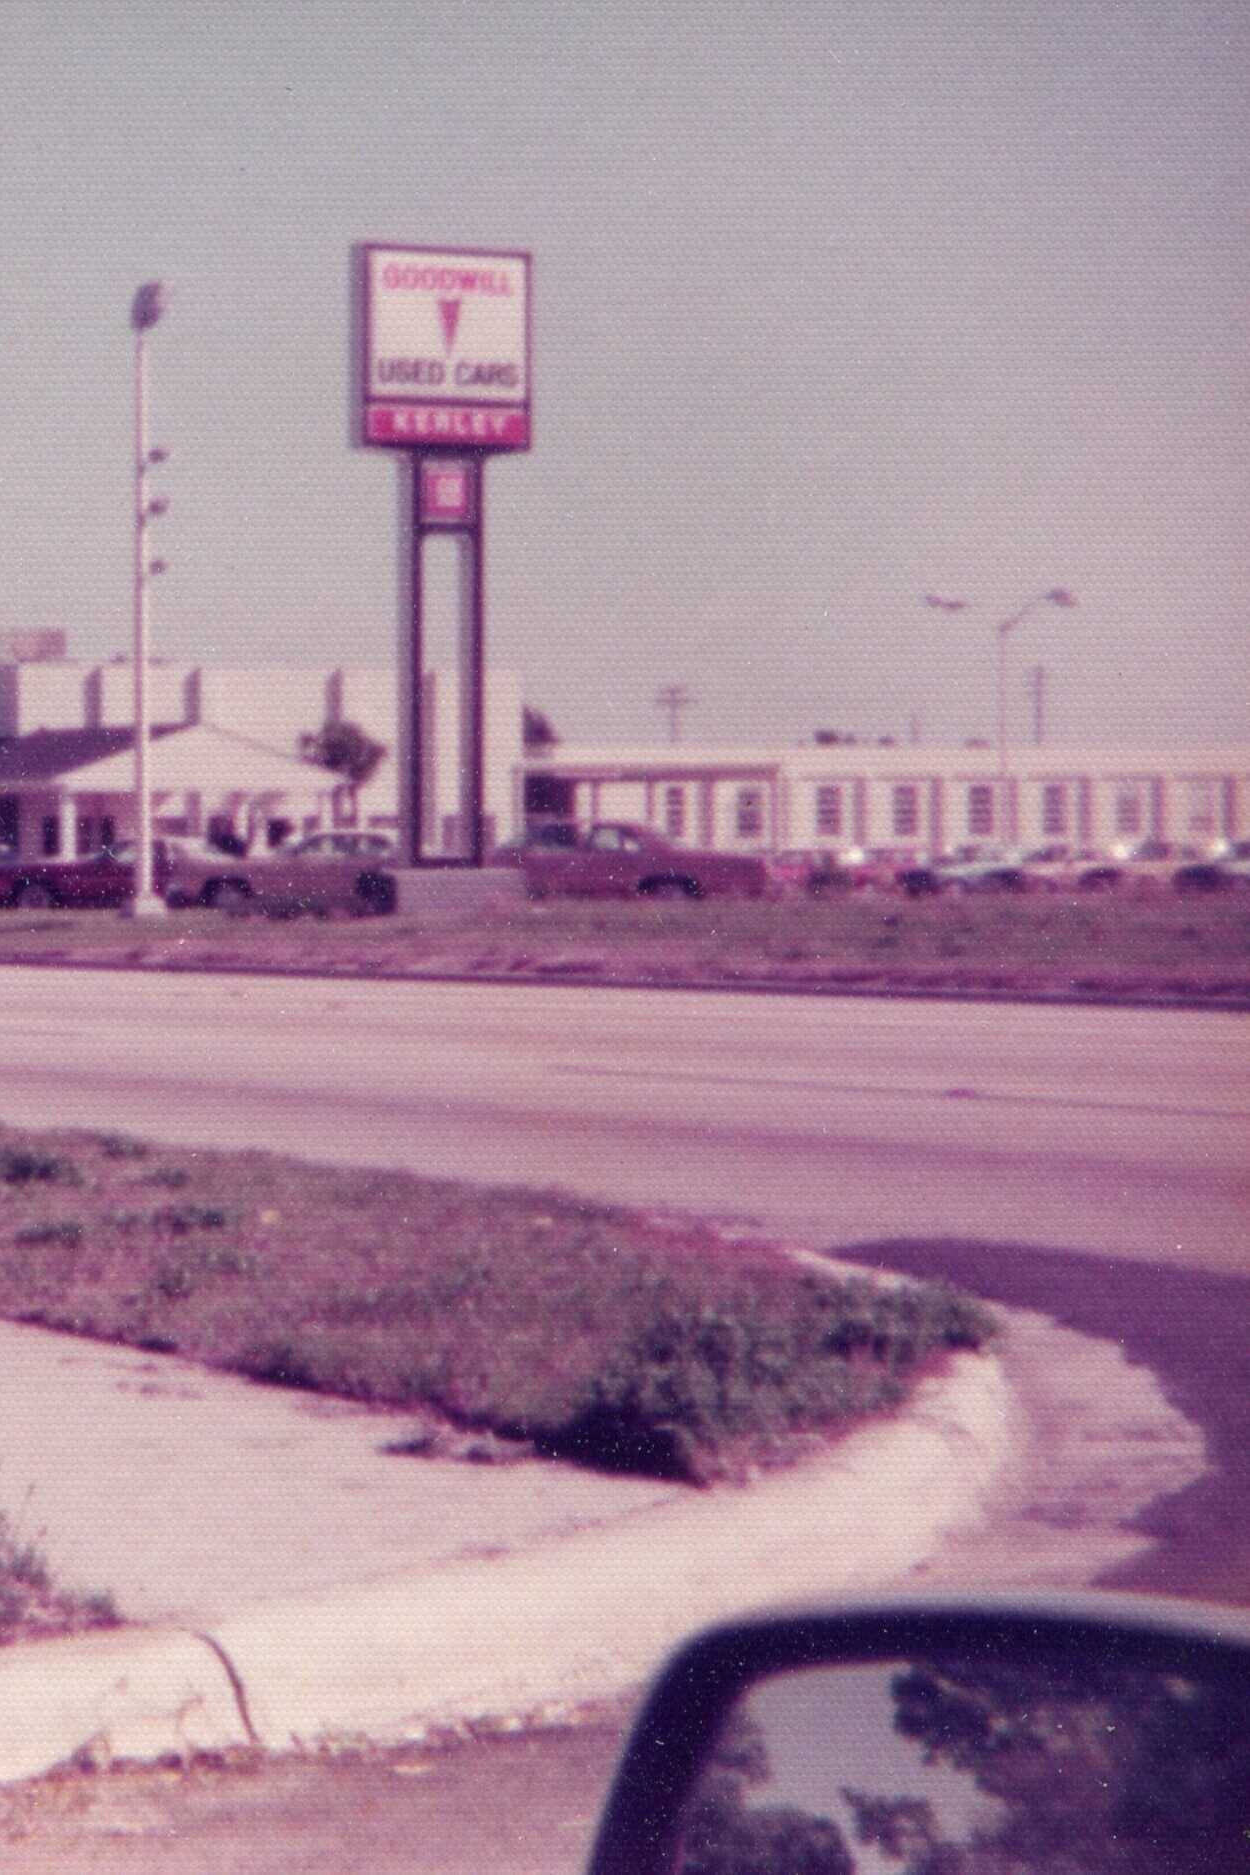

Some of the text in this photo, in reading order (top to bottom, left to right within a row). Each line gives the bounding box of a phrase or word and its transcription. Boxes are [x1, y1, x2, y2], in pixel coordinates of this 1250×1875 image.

[382, 264, 513, 296] GOODWILL
[376, 357, 518, 388] USED CARS
